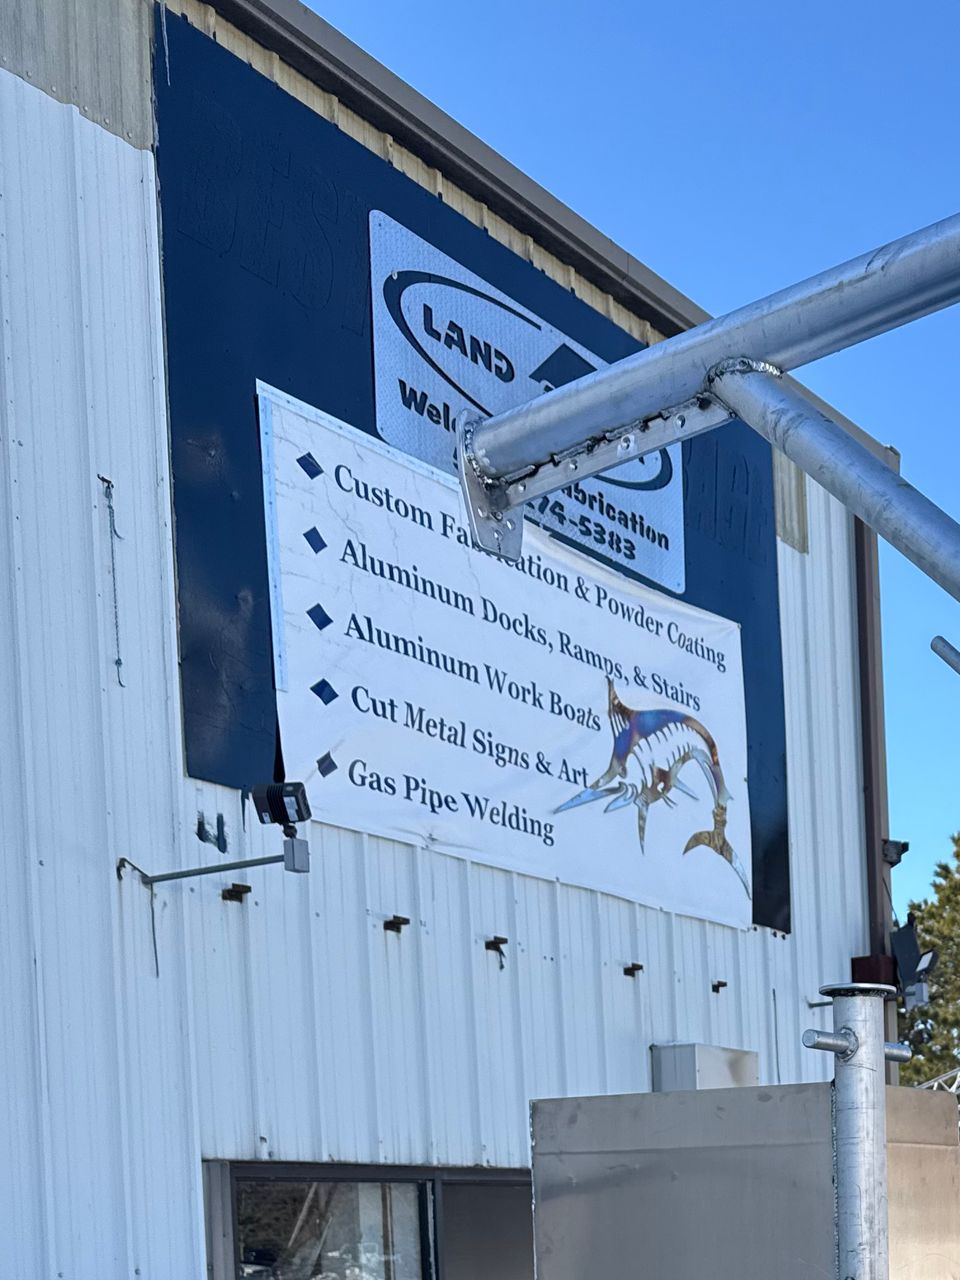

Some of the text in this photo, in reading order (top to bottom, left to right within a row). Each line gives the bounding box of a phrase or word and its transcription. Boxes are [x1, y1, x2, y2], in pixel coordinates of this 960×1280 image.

[423, 303, 515, 384] LAND
[334, 464, 727, 673] Custom Faation & Powder Coating
[339, 538, 702, 712] Aluminum Docks, Ramps, & Stairs
[344, 613, 601, 731] Aluminum Work Boats
[351, 685, 590, 788] Cut Metal Signs & Art
[348, 759, 555, 847] Gas Pipe Welding
